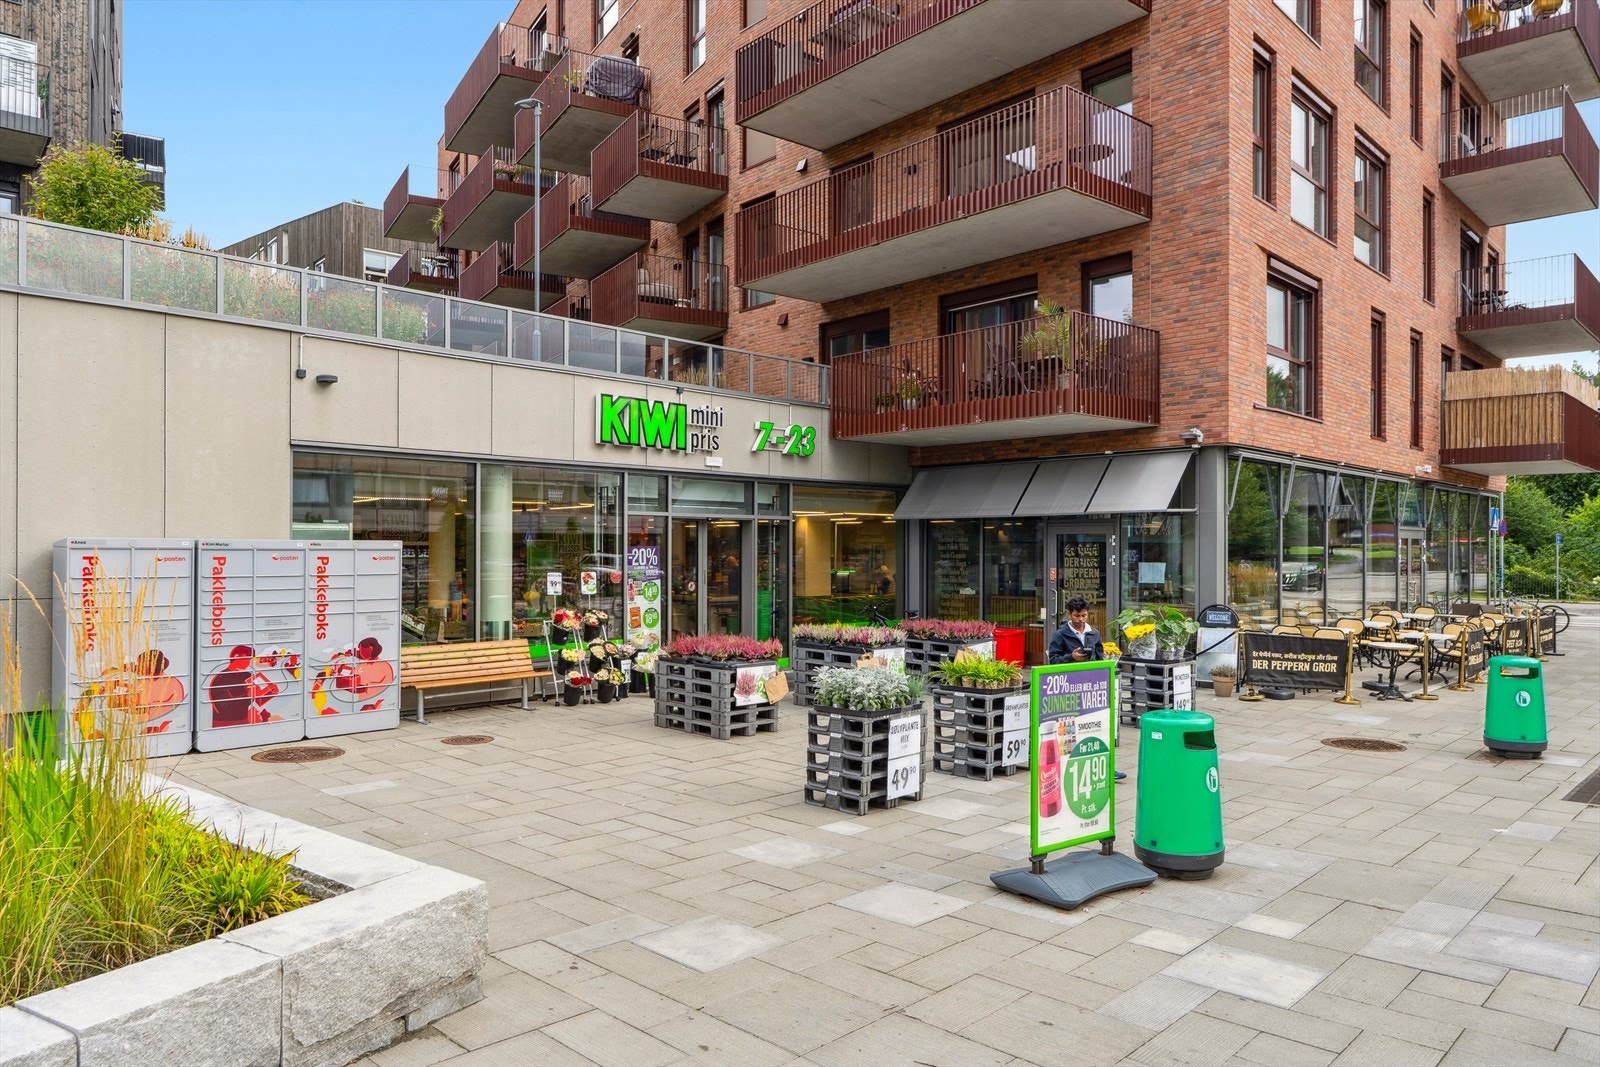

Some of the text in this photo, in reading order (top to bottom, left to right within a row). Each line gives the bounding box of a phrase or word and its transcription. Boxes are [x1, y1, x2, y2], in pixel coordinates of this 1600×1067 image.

[597, 393, 687, 451] KIWI
[690, 405, 723, 427] mini
[690, 429, 720, 452] pris
[753, 421, 816, 457] 7-23
[382, 513, 410, 526] KIWI
[559, 533, 580, 544] KIWI
[628, 547, 658, 566] -20%
[1064, 557, 1080, 567] DER
[211, 556, 227, 646] Pakkeboks
[316, 556, 330, 640] Pakkeboks
[1252, 659, 1337, 673] DER PEPPERN GROR
[1042, 674, 1070, 695] -20%
[1070, 683, 1083, 693] ELLER
[1042, 690, 1108, 714] SUNNERE VARER
[1078, 721, 1102, 731] SMOOTHIE
[900, 734, 910, 745] MIX
[1087, 741, 1100, 752] 21,40
[1087, 804, 1097, 813] stk.
